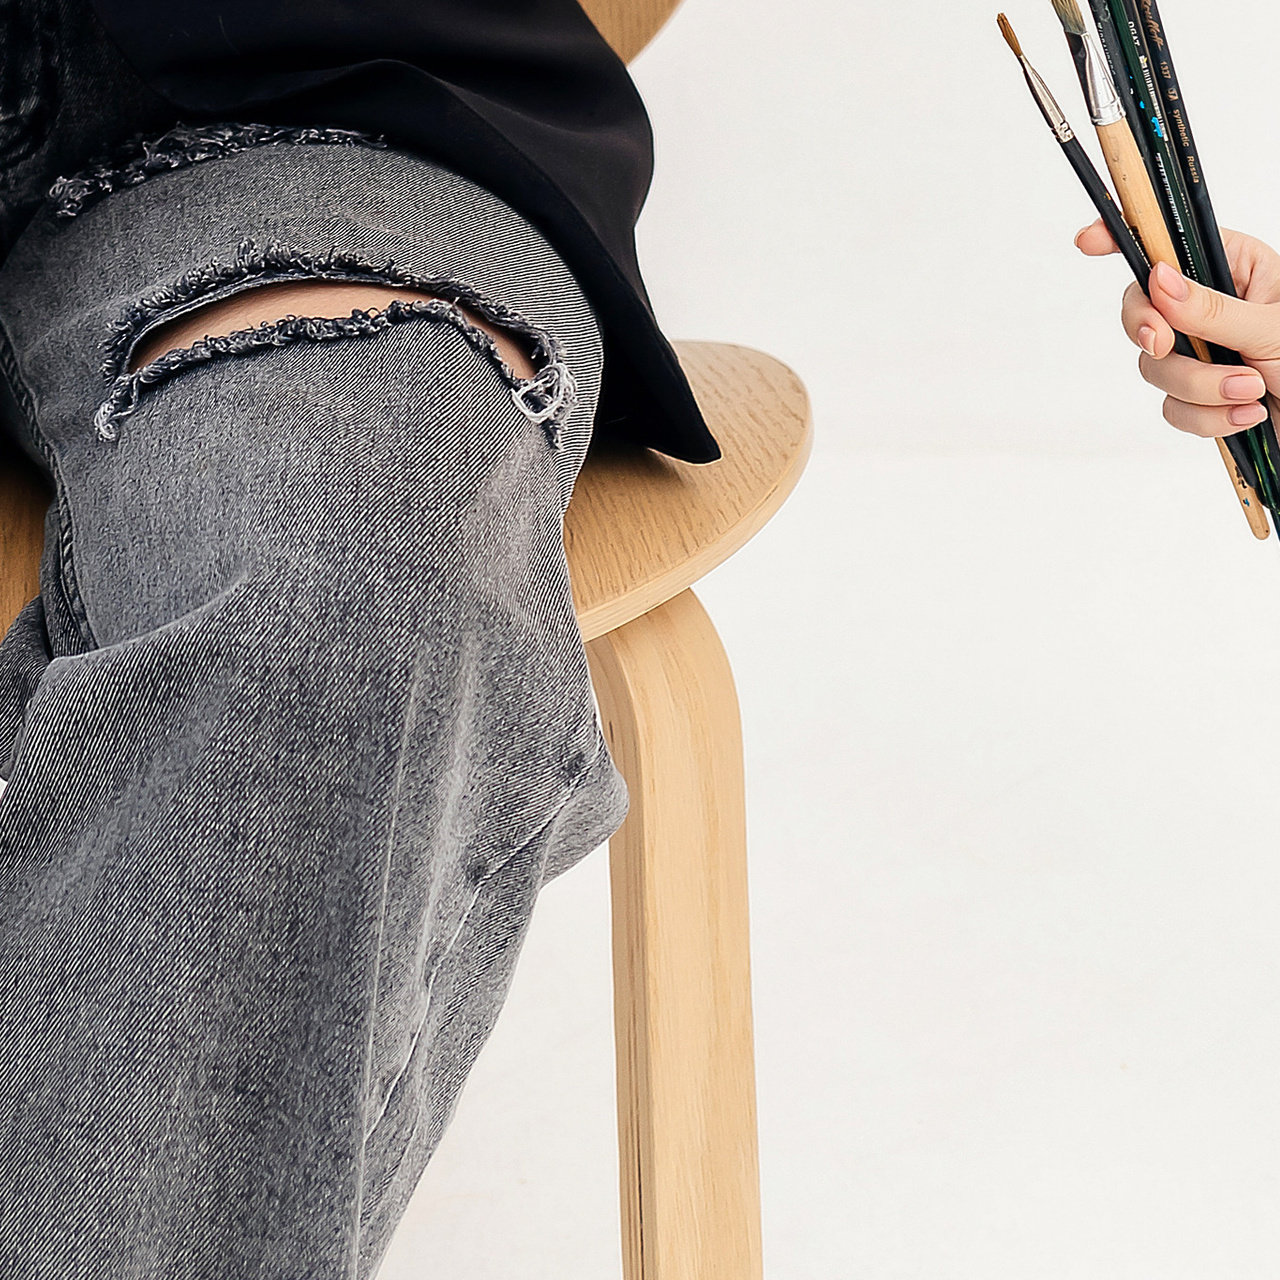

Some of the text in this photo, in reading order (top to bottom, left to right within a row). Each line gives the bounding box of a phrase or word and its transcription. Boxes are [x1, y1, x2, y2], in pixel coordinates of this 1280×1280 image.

[1160, 61, 1171, 79] 1337
[1173, 109, 1190, 147] synthetic
[1186, 155, 1200, 184] Russia
